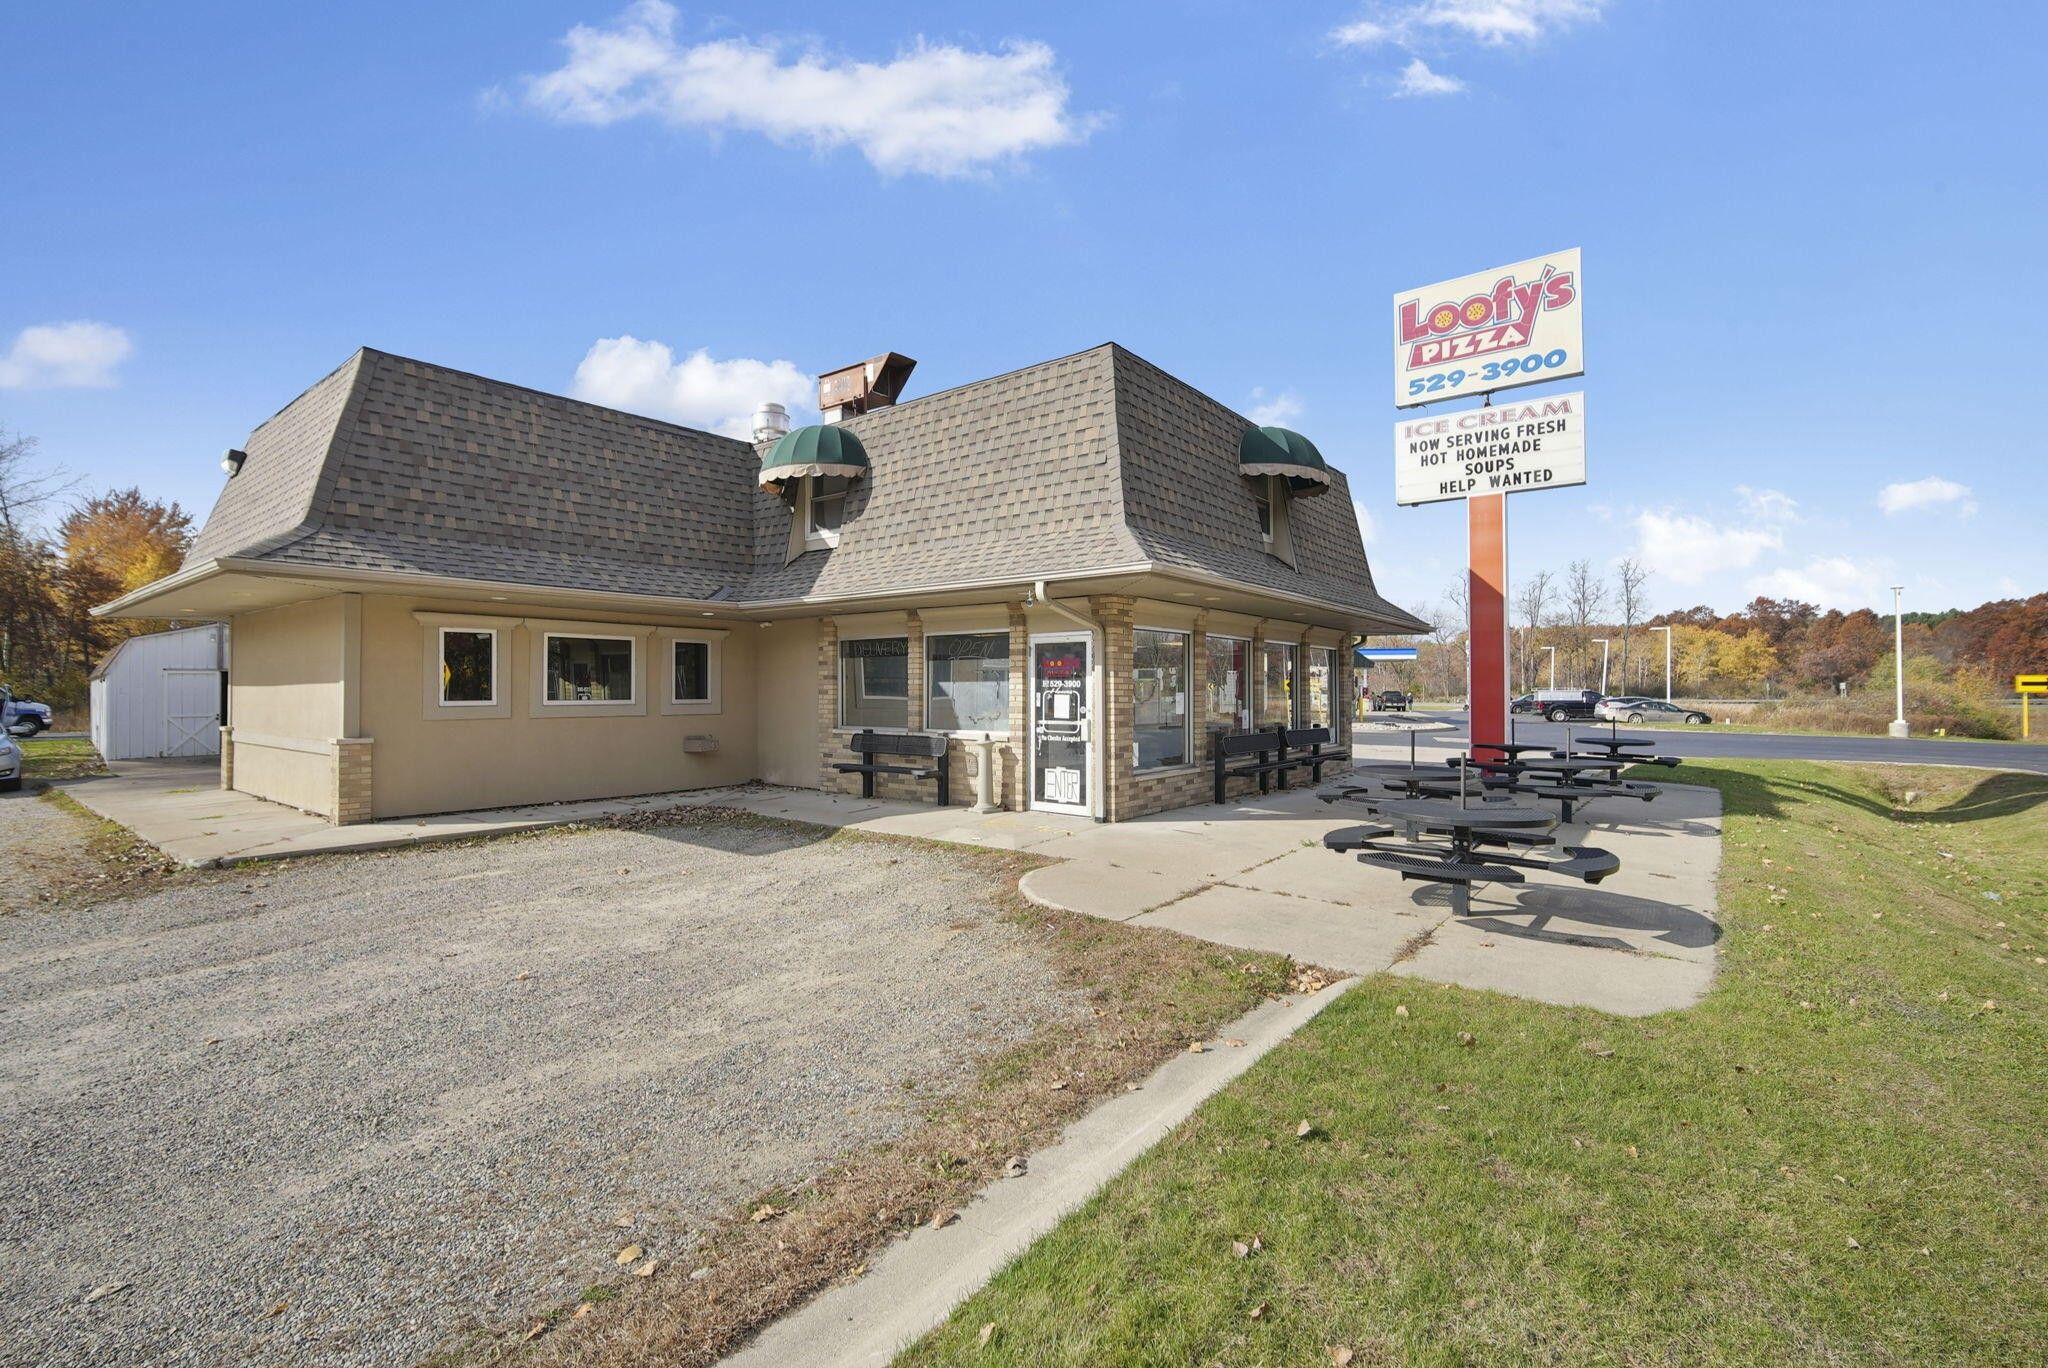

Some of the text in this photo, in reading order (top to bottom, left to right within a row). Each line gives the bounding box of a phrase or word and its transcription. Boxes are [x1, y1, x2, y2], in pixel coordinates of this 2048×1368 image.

[1400, 265, 1575, 345] Loofy's
[1421, 325, 1525, 363] PIZZA
[1408, 348, 1568, 396] 529-3900
[1404, 399, 1573, 439] ICE CREAM
[1409, 418, 1567, 454] NOW SERVING FRESH
[1420, 438, 1542, 467] HOT HOMEMADE
[1465, 457, 1516, 476] SOUPS
[1440, 468, 1554, 495] HELP WANTED
[949, 638, 994, 657] OPEN
[1050, 680, 1082, 688] 529-3900
[1046, 770, 1079, 800] ENTER
